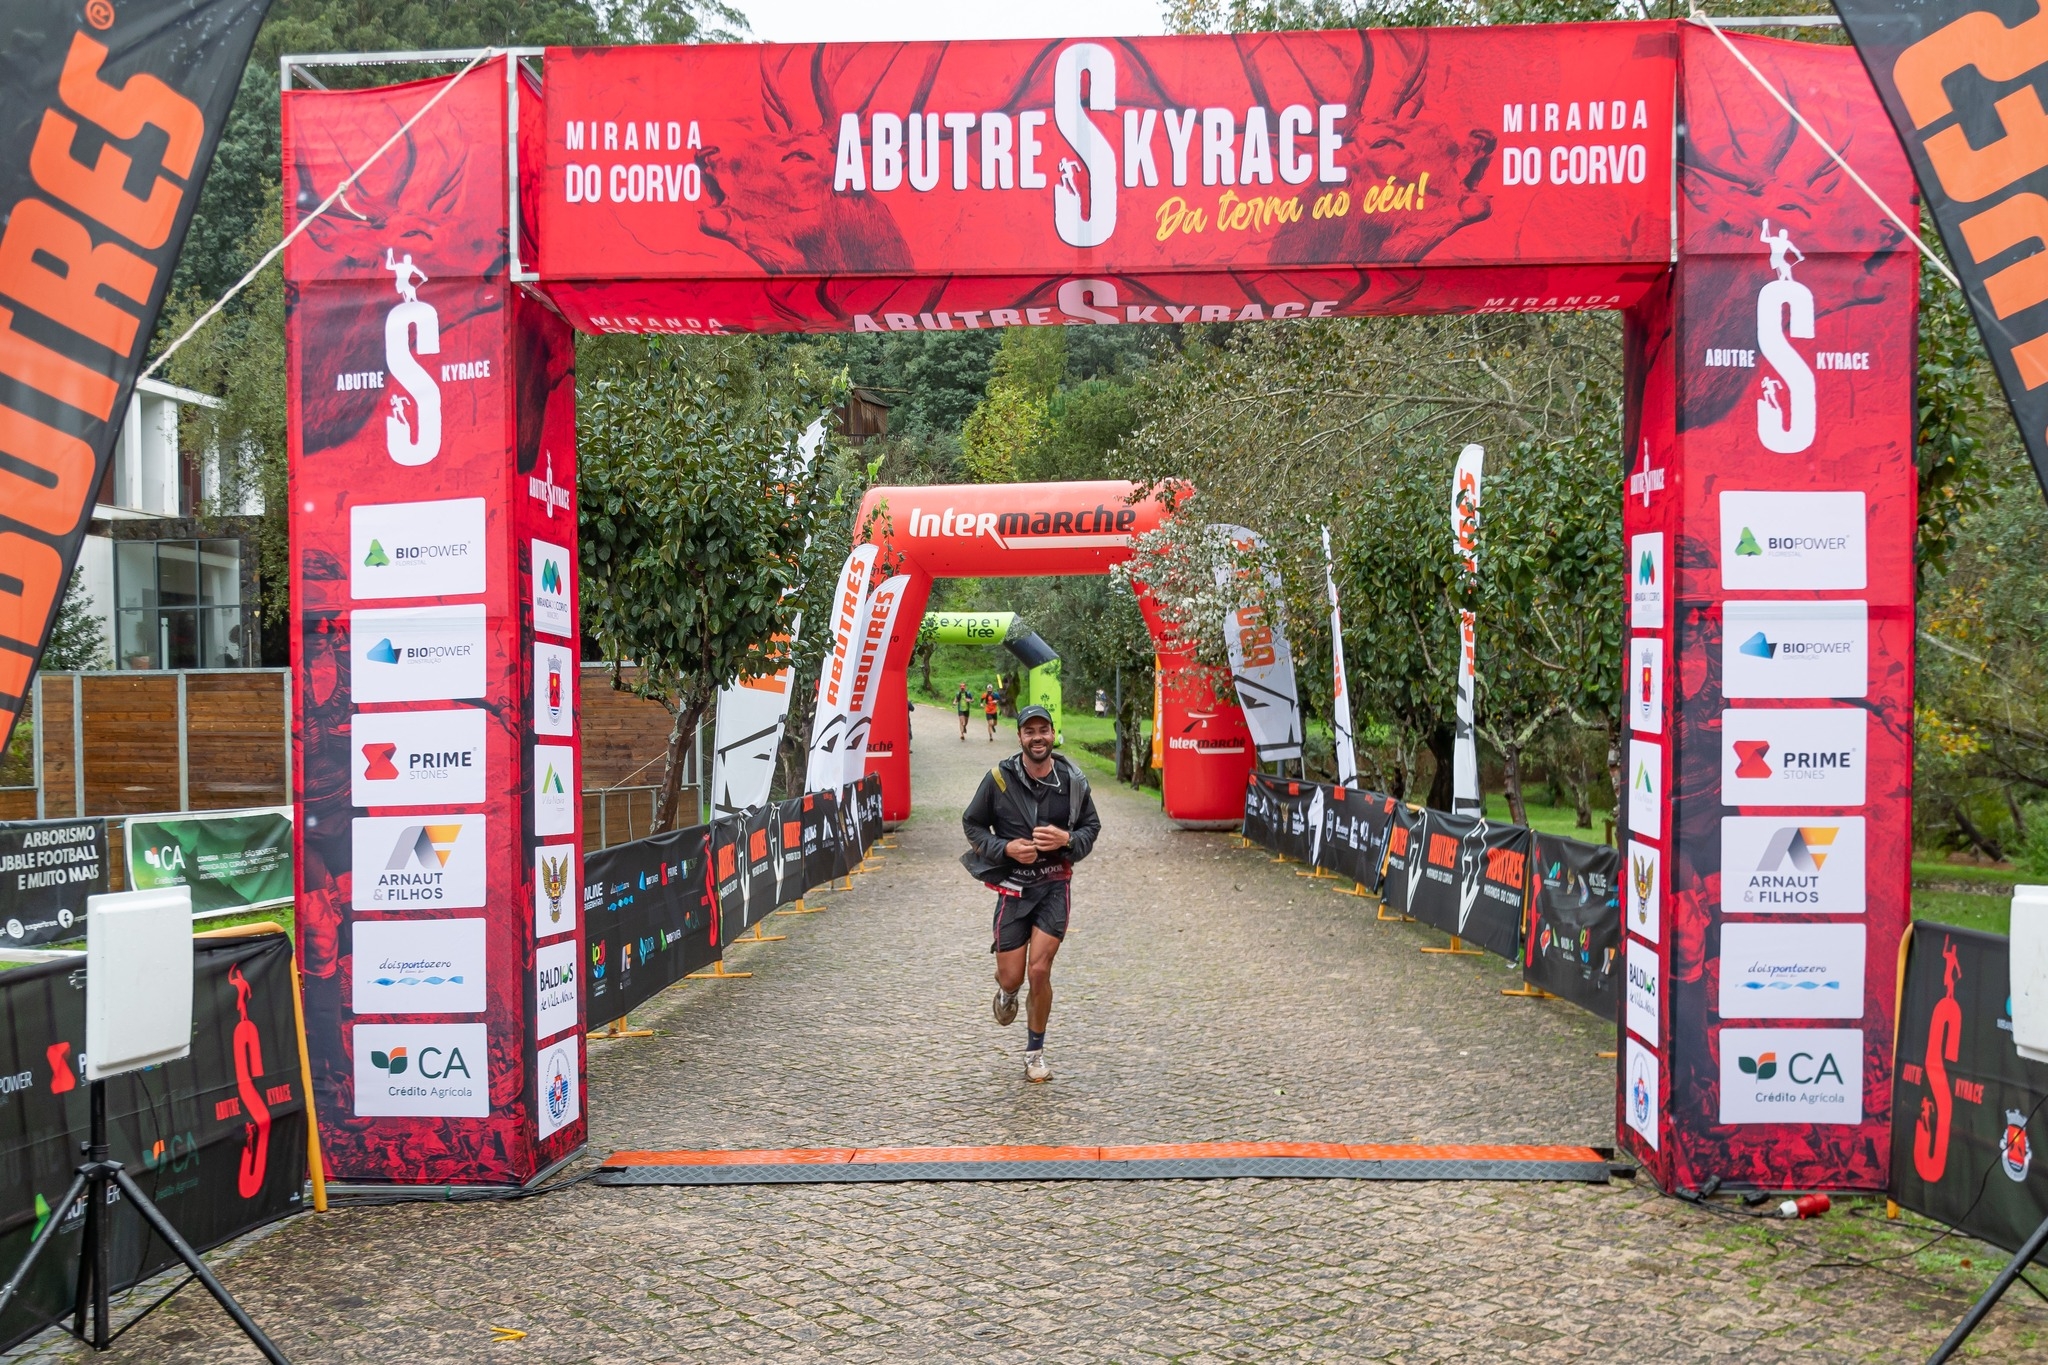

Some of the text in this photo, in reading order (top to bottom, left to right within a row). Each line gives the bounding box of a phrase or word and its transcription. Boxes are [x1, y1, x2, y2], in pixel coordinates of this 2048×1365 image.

[1503, 100, 1648, 132] MIRANDA
[566, 121, 702, 150] MIRANDA
[833, 110, 1046, 192] ABUTRE
[1503, 144, 1646, 186] DO CORVO
[566, 163, 701, 203] DO CORVO
[1156, 172, 1431, 241] Da terra ao céu!
[1484, 295, 1620, 307] MIRANDA
[589, 316, 723, 329] MIRANDA
[1705, 348, 1755, 368] ABUTRE
[336, 371, 385, 391] ABUTRE
[395, 542, 468, 559] BIOPOWER
[1768, 537, 1846, 550] BIOPOWER
[827, 556, 866, 707] ABUTRES
[967, 625, 995, 638] tree
[407, 645, 471, 659] BIOPOWER
[850, 590, 895, 712] ABUTRES
[1783, 642, 1850, 654] BIOPOWER
[409, 751, 472, 770] PRIME
[1784, 752, 1851, 768] PRIME
[409, 768, 448, 780] STONES
[1784, 770, 1825, 780] STONES
[23, 825, 95, 848] ARBORISMO
[0, 845, 99, 872] UBBLE FOOTBALL
[160, 845, 187, 870] CA
[18, 864, 99, 890] E MUITO MAIS
[378, 872, 443, 886] ARNAUT
[1749, 876, 1819, 888] ARNAUT
[373, 887, 443, 901] & FILHOS
[1744, 891, 1819, 903] & FILHOS
[379, 958, 452, 973] doispontozero
[1748, 961, 1827, 977] doispontozero
[418, 1046, 471, 1080] CA
[1788, 1052, 1844, 1085] CA
[388, 1085, 472, 1098] Crédito Agrícola
[1755, 1092, 1845, 1104] Crédito Agrícola
[170, 1131, 200, 1173] CA
